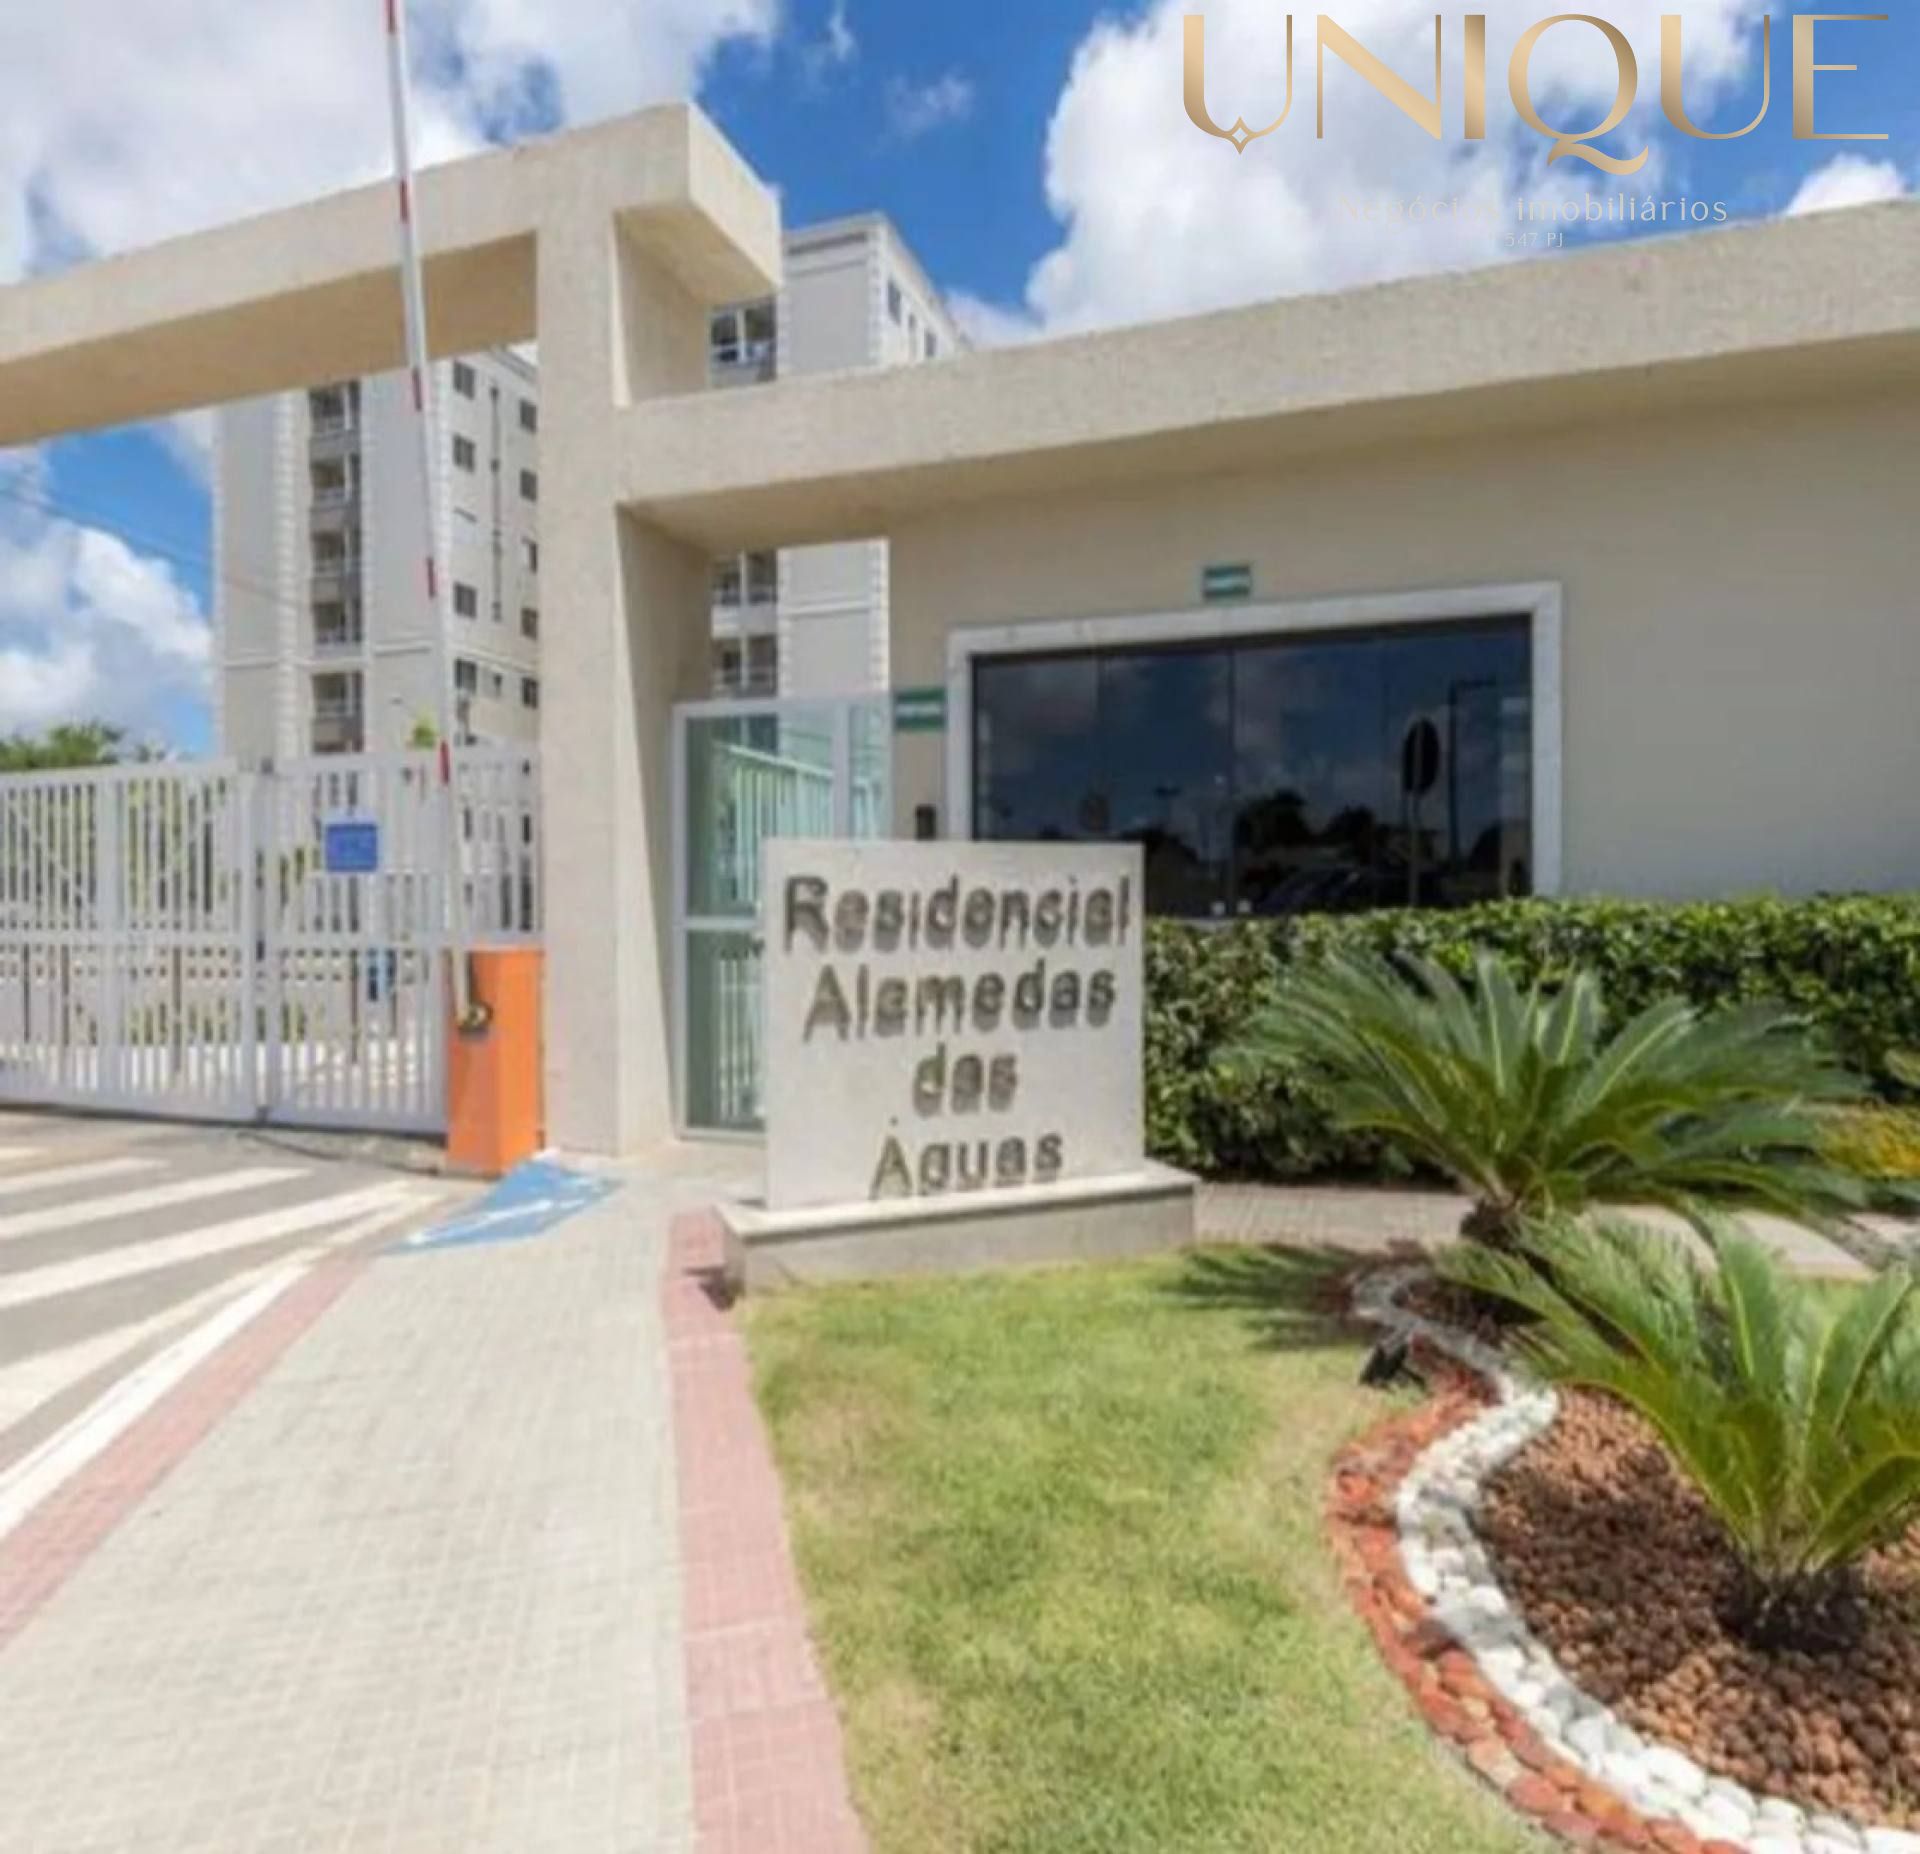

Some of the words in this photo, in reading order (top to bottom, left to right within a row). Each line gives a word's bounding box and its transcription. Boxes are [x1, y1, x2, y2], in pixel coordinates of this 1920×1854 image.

[783, 874, 1131, 950] Residencial
[803, 958, 1117, 1042] Alamedas
[913, 1042, 1018, 1116] das
